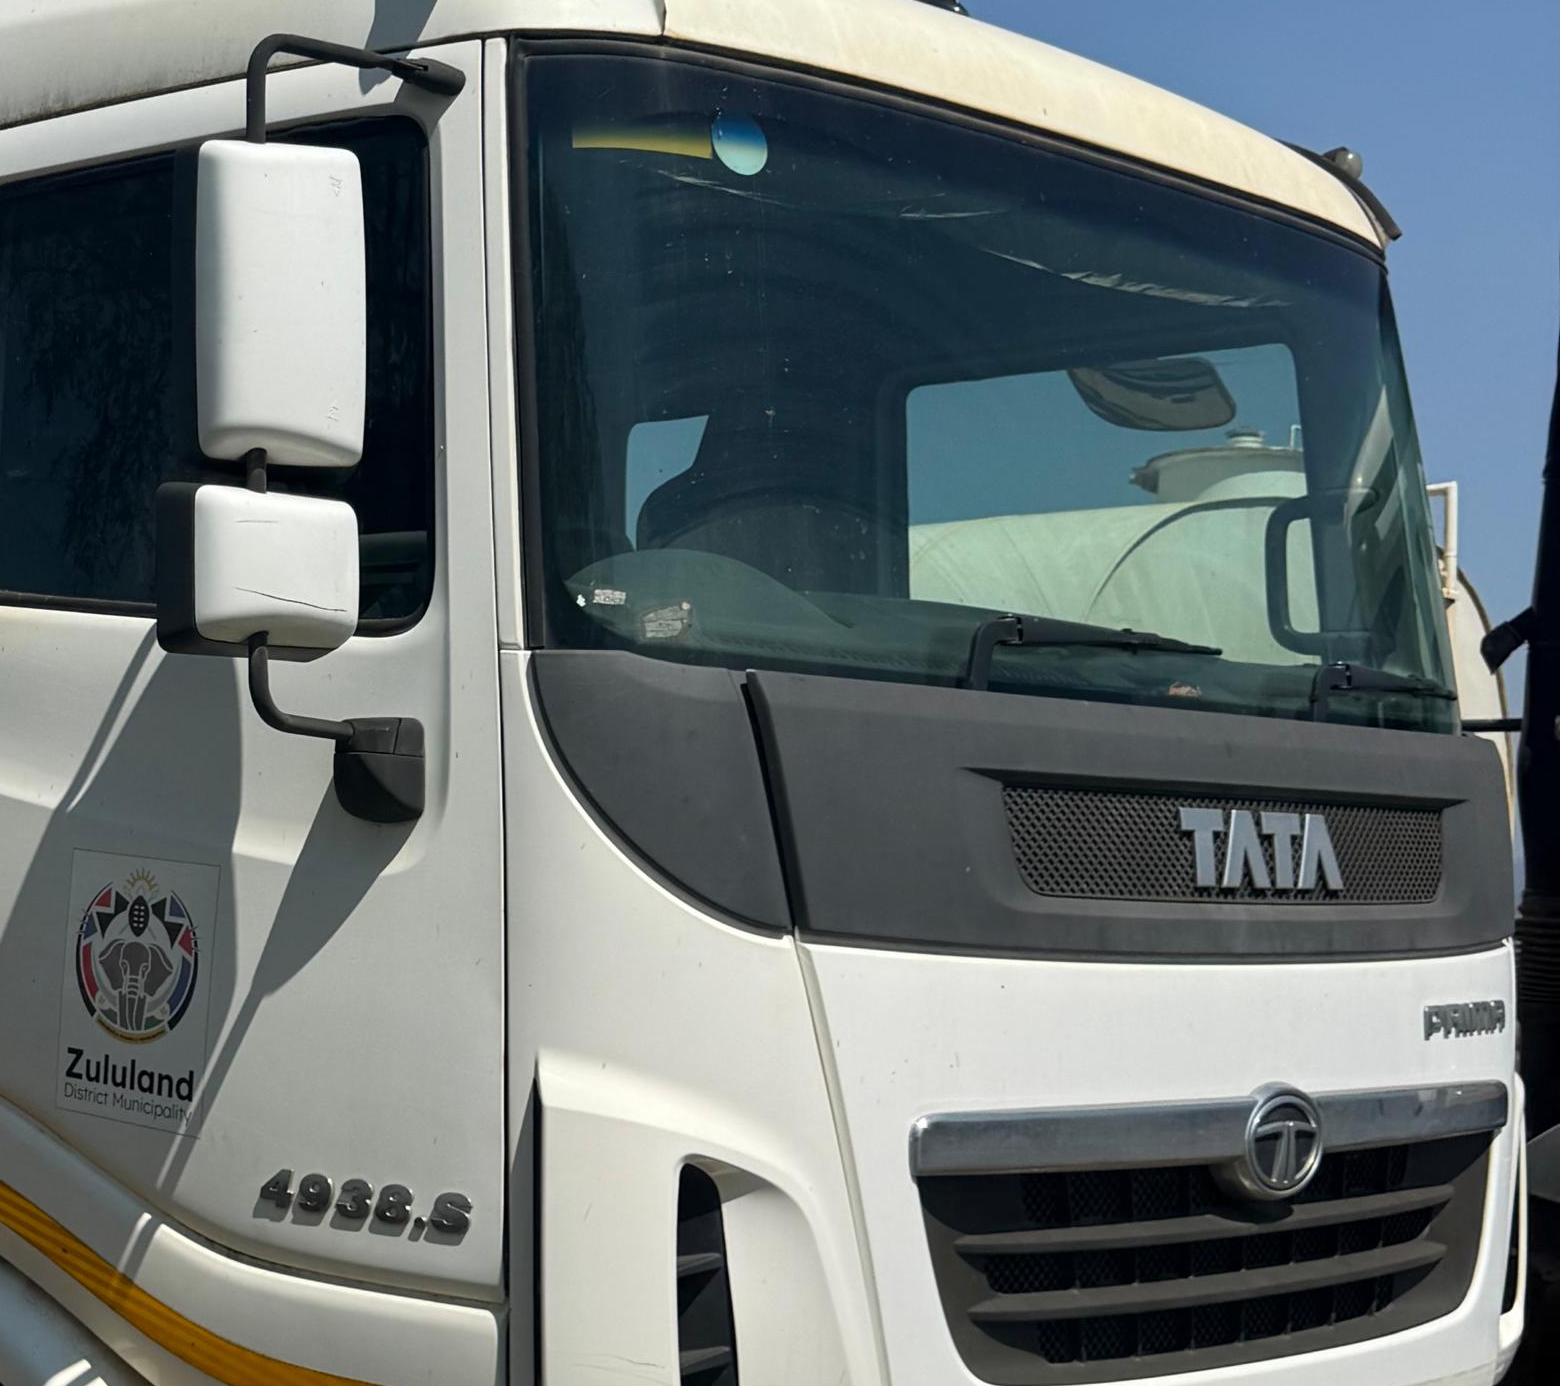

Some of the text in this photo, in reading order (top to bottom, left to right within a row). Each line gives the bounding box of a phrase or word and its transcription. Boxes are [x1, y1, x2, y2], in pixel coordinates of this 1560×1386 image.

[1180, 807, 1343, 890] TATA
[66, 1047, 194, 1102] Zululand
[63, 1082, 192, 1126] District Municipality
